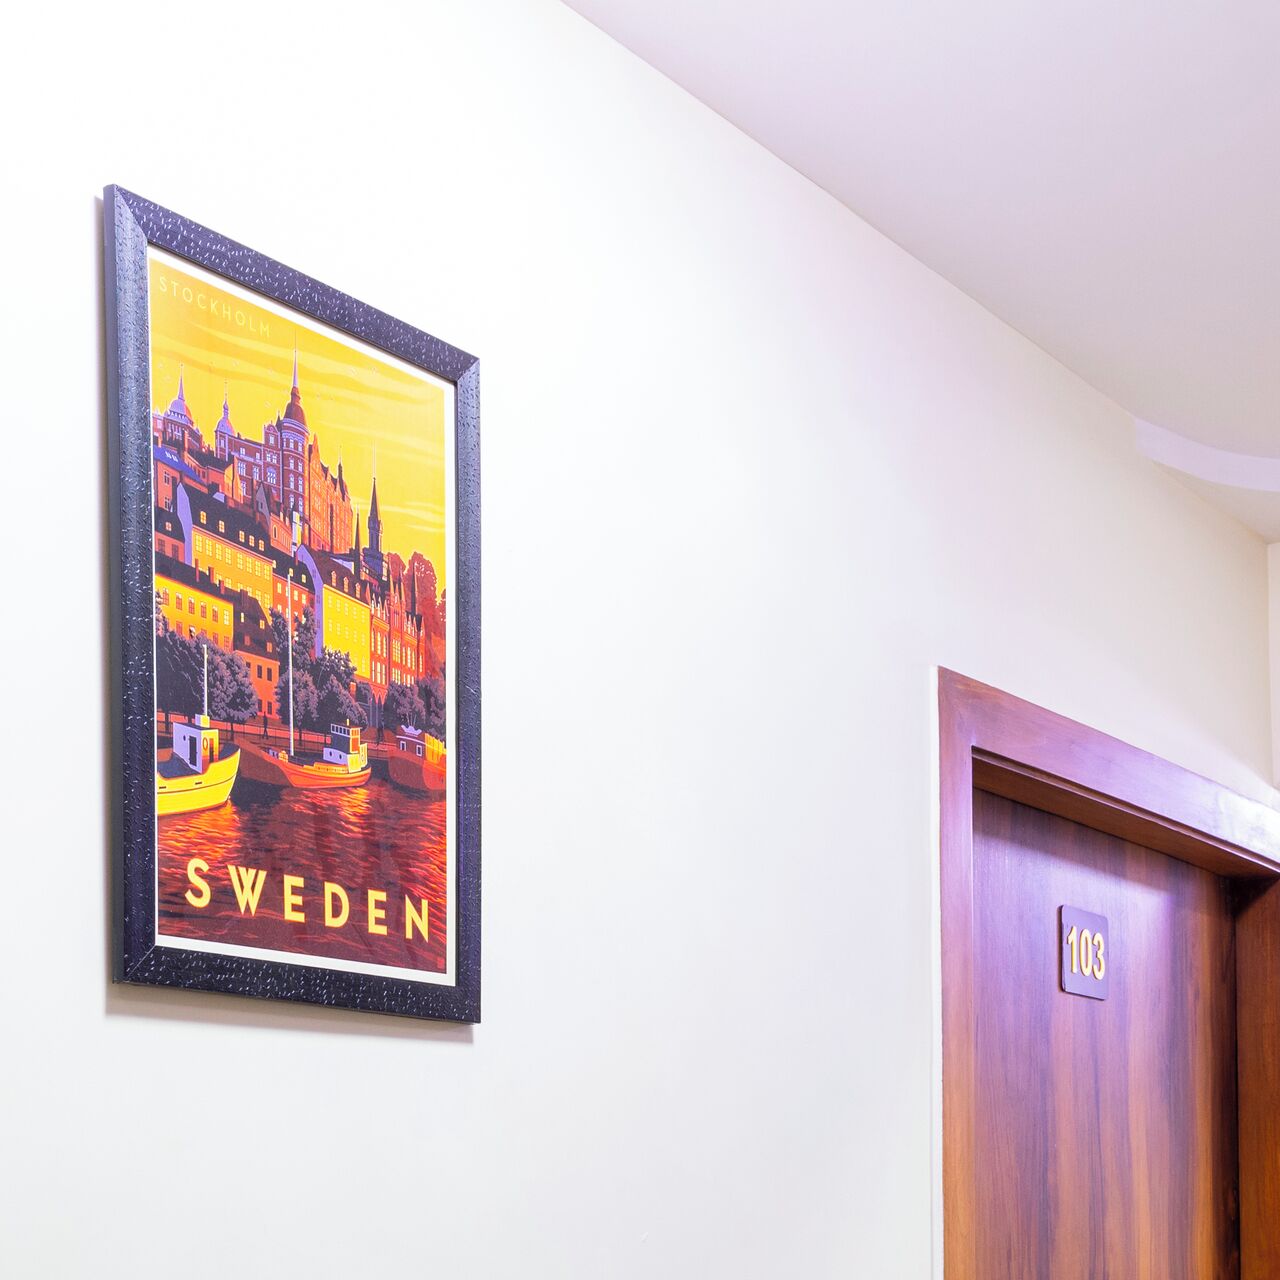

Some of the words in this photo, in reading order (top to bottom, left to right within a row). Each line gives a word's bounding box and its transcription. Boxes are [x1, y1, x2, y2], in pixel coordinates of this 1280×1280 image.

[159, 276, 270, 338] STOCKHOLM
[184, 857, 429, 943] SWEDEN
[1067, 925, 1106, 981] 103
